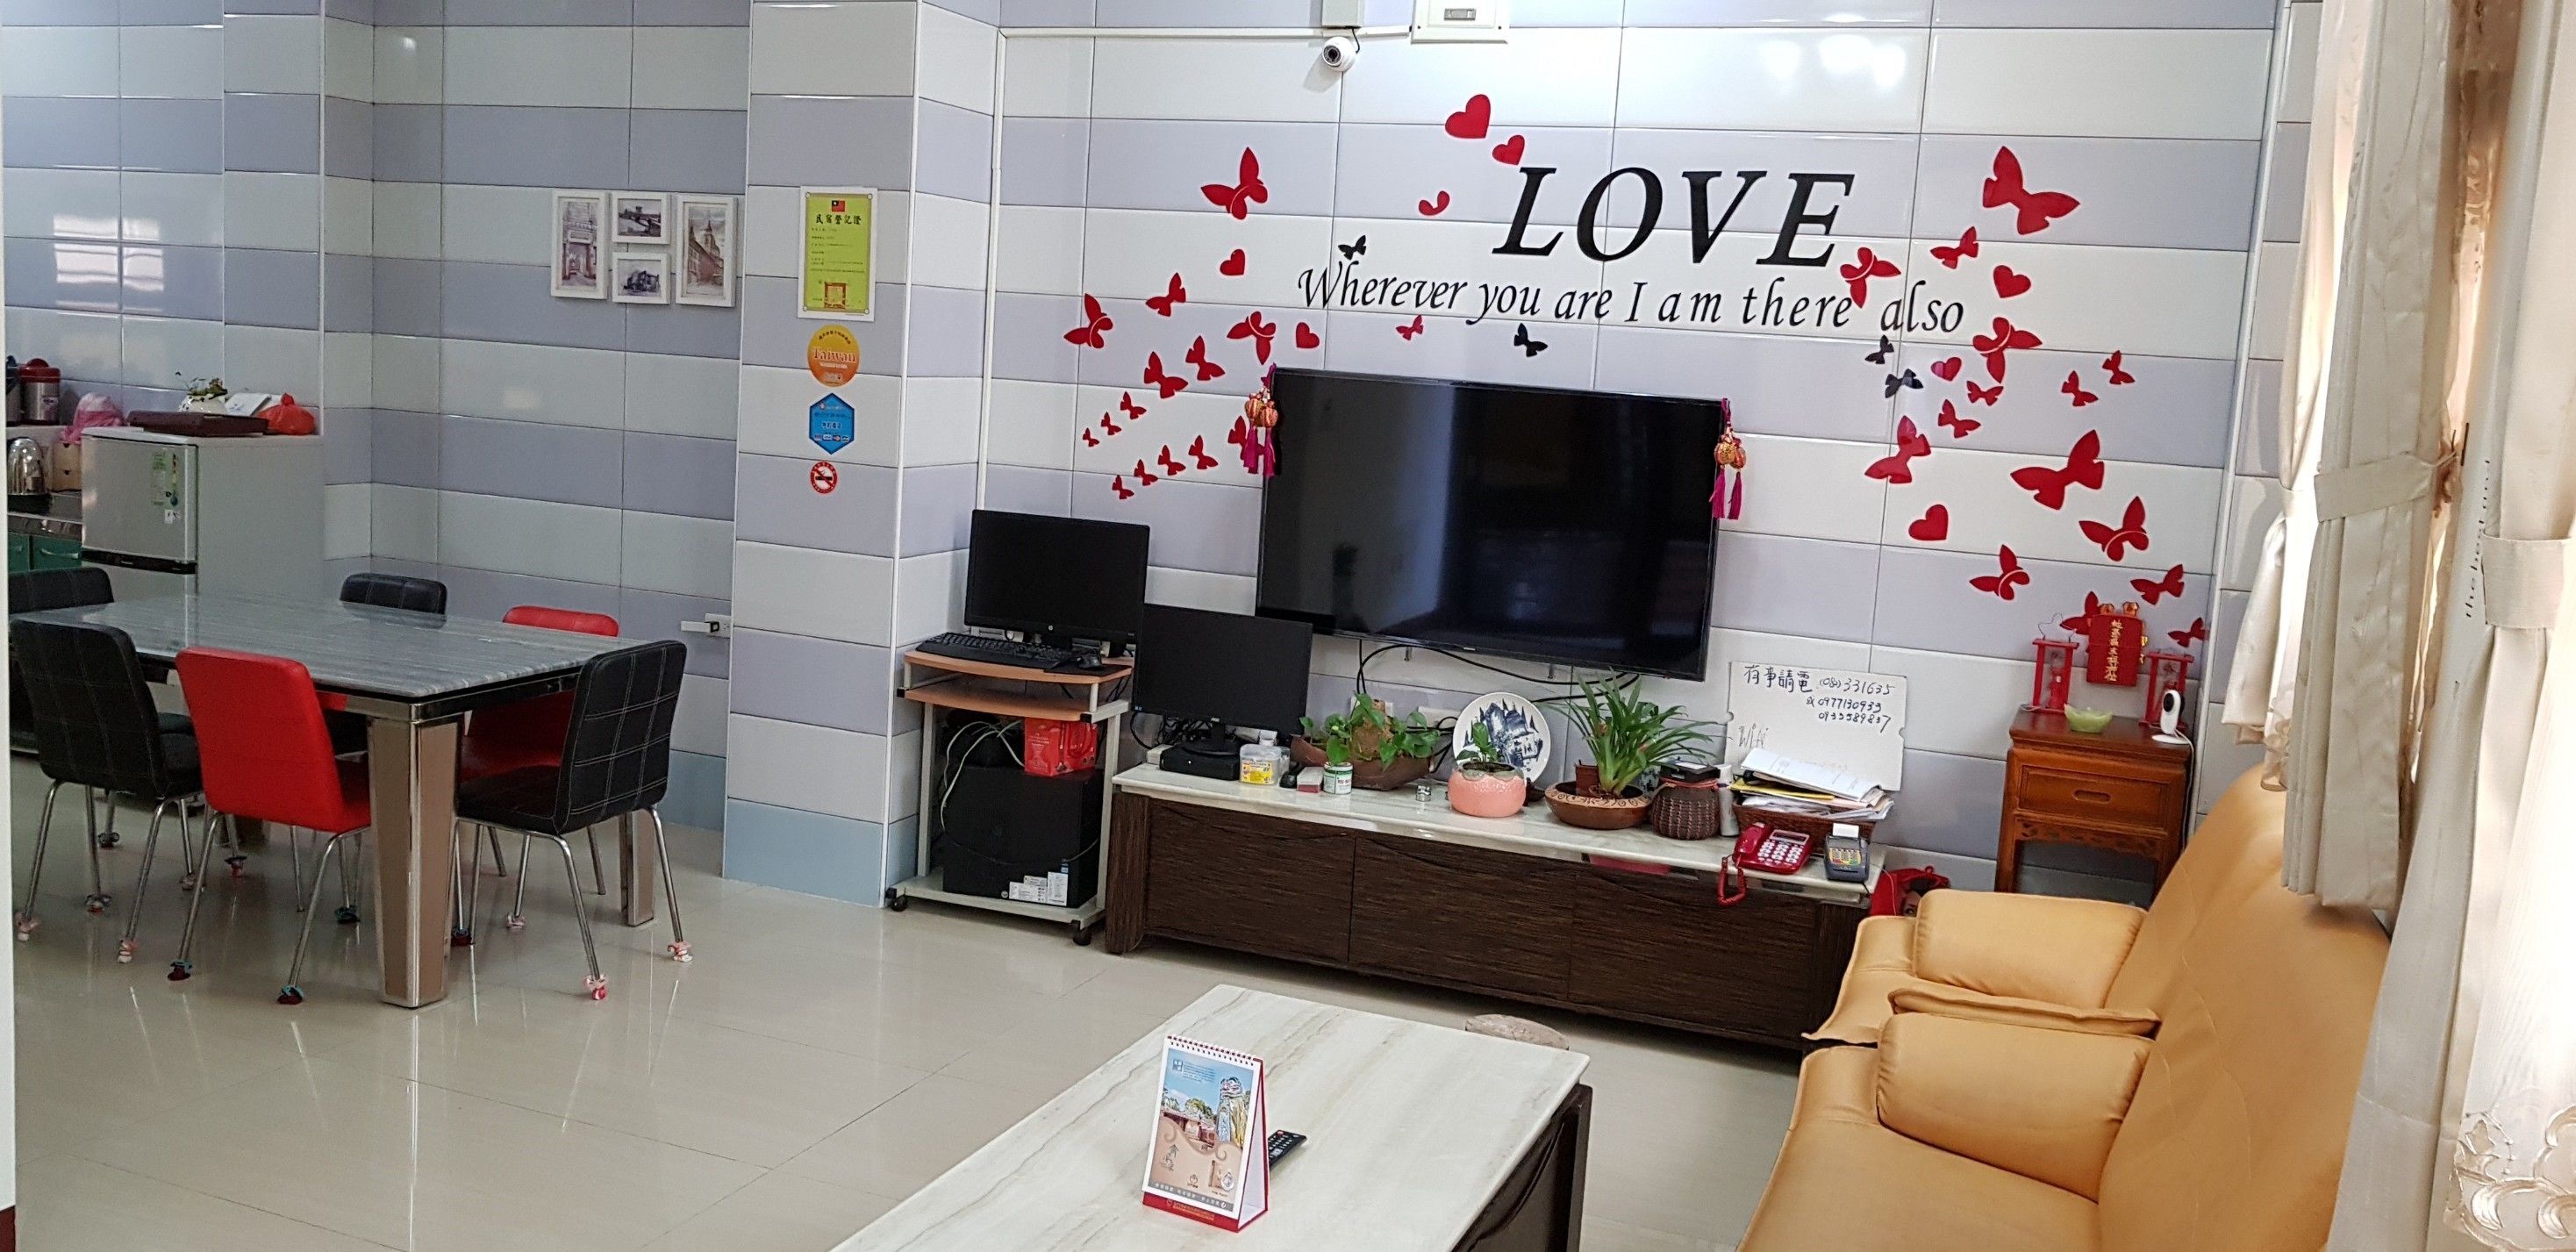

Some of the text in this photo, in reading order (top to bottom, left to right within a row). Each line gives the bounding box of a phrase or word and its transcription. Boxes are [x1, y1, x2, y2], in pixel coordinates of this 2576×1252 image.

[1492, 167, 1856, 267] LOVE
[1298, 261, 1964, 333] Wherever you are I am there also
[812, 347, 855, 362] Taiwan
[1744, 664, 1812, 693] 有事請電
